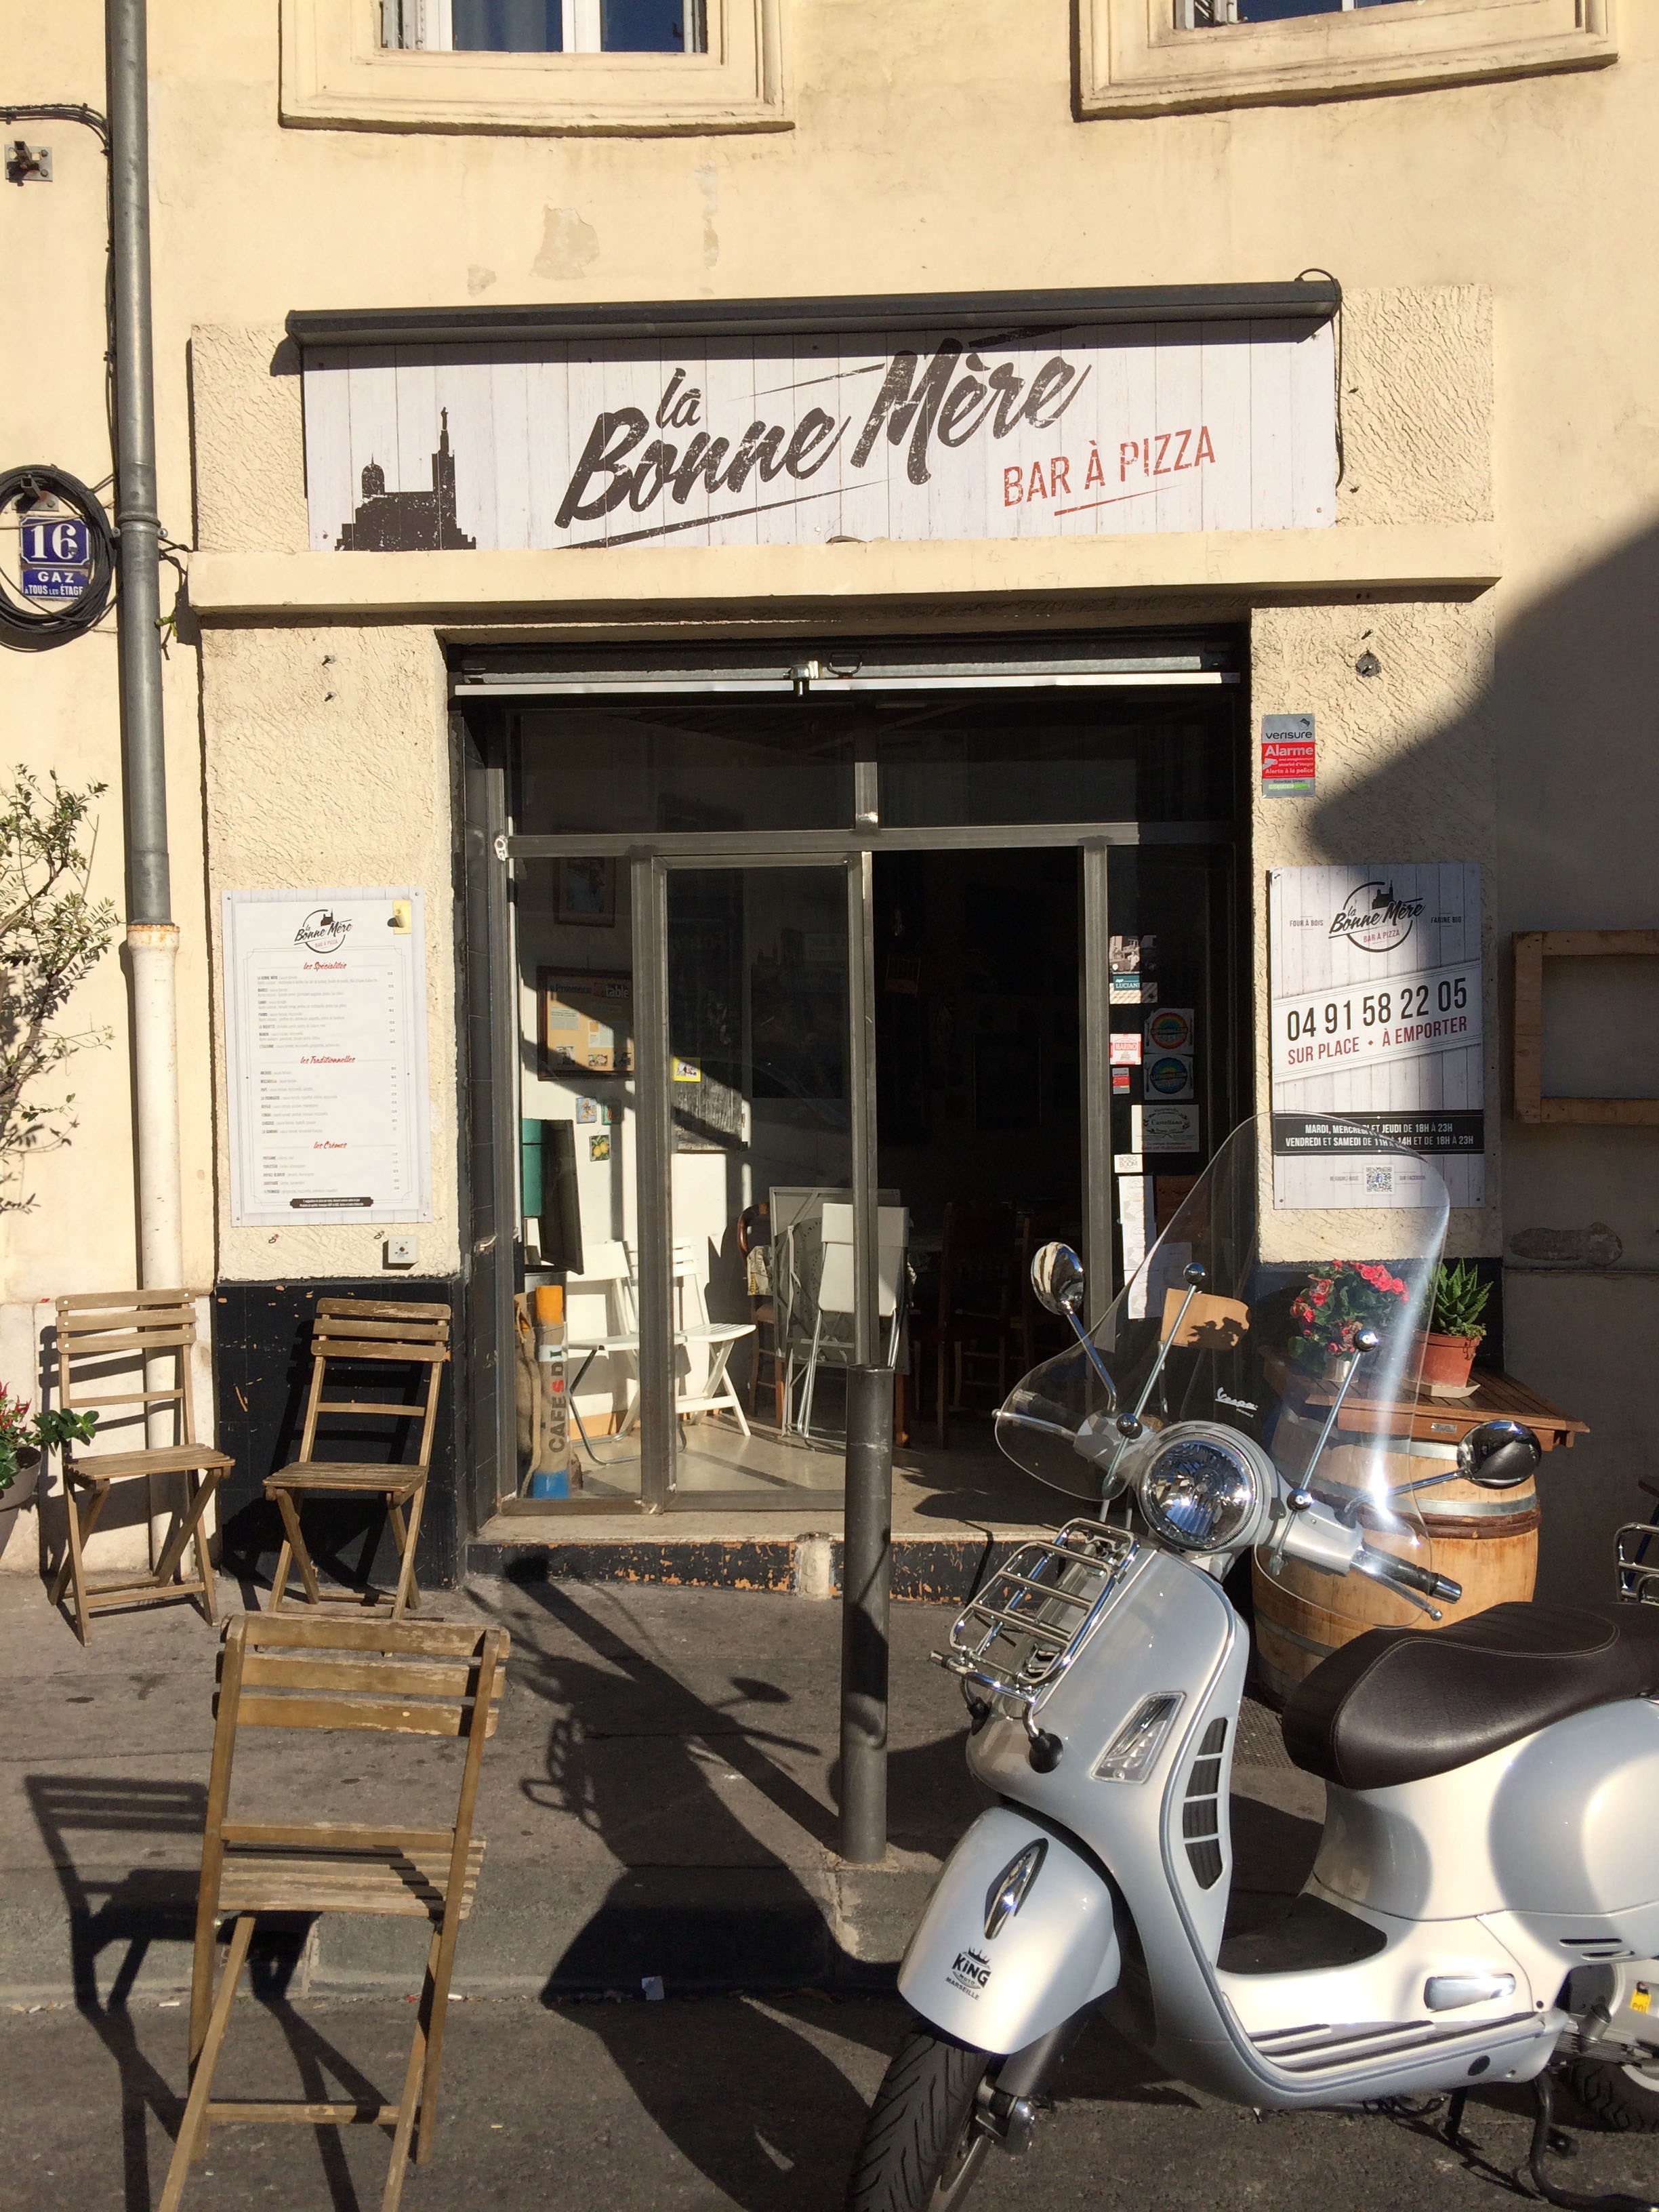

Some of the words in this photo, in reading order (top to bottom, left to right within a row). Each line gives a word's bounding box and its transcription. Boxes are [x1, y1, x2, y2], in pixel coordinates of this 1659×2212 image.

[655, 367, 701, 428] la
[554, 407, 851, 529] Bonne
[851, 338, 1092, 485] Mère
[1004, 456, 1071, 507] BAR
[1084, 440, 1105, 489] À
[1120, 426, 1216, 482] PIZZA
[30, 524, 77, 560] 16
[38, 571, 74, 583] GAZ
[28, 585, 47, 594] TOUS
[60, 583, 83, 596] ÉTAGE
[1265, 731, 1313, 739] verisure
[1265, 743, 1313, 756] Alarme
[1329, 912, 1382, 933] Bonne
[1382, 900, 1427, 926] Mère
[1348, 905, 1356, 916] la
[294, 928, 326, 942] Bonne
[1382, 929, 1400, 939] PIZZA
[1288, 1010, 1316, 1041] 04
[1325, 1000, 1351, 1033] 91
[1363, 993, 1391, 1026] 58
[1401, 985, 1429, 1019] 22
[1438, 977, 1467, 1012] 05
[1288, 1046, 1313, 1065] SUR
[1318, 1037, 1359, 1059] PLACE
[1382, 1029, 1391, 1046] À
[1395, 1016, 1467, 1044] EMPORTER
[1305, 1124, 1331, 1134] MARDI,
[1382, 1124, 1401, 1133] JEUDI
[1404, 1124, 1412, 1133] DE
[1415, 1124, 1429, 1133] 18H
[1438, 1123, 1453, 1132] 23H
[1286, 1137, 1322, 1147] VENDREDI
[1323, 1137, 1332, 1146] ET
[1333, 1137, 1361, 1146] SAMEDI
[1363, 1137, 1372, 1146] DE
[1414, 1137, 1422, 1145] ET
[1424, 1136, 1434, 1145] DE
[1436, 1136, 1450, 1145] 18H
[1458, 1136, 1474, 1145] 23H
[945, 1977, 981, 2001] MARSEILLE
